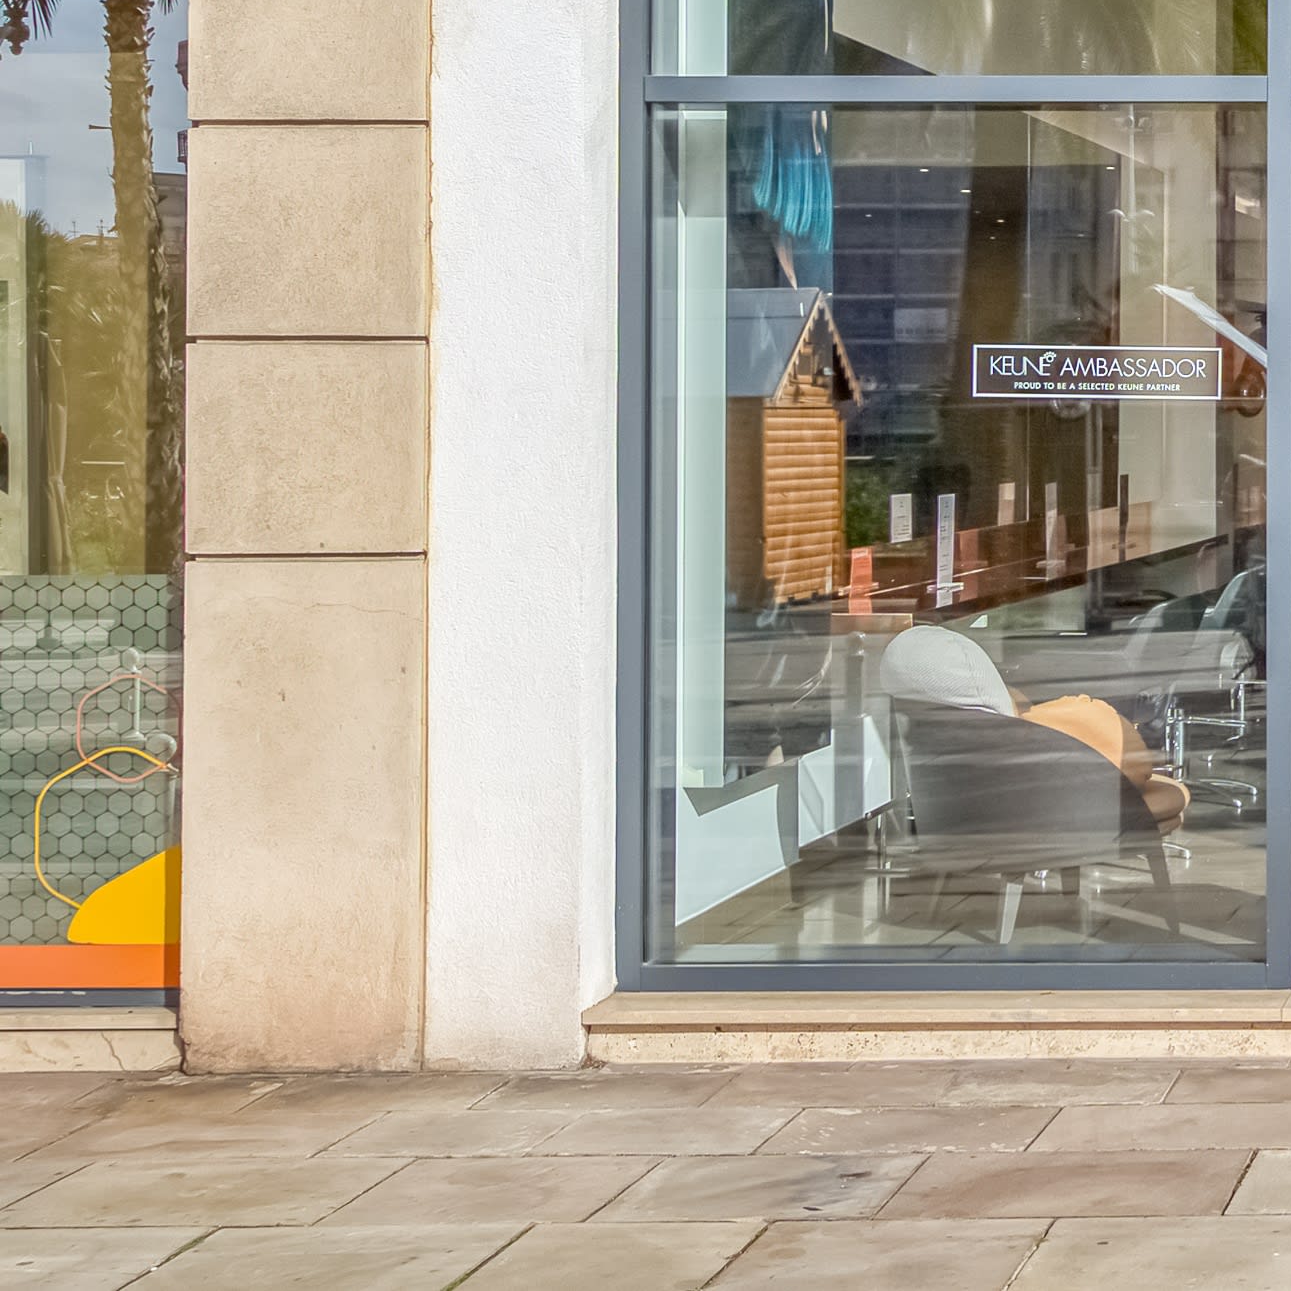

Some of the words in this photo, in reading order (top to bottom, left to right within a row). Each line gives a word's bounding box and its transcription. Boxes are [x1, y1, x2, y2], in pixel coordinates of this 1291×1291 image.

[989, 353, 1053, 377] KEUNE
[1059, 356, 1207, 379] AMBASSADOR
[1013, 381, 1042, 390] PROUD
[1043, 382, 1055, 390] TO
[1057, 382, 1067, 391] BE
[1068, 382, 1076, 391] A
[1078, 382, 1116, 391] SELECTED
[1117, 383, 1144, 391] KEUNE
[1146, 383, 1181, 392] PARTNER
